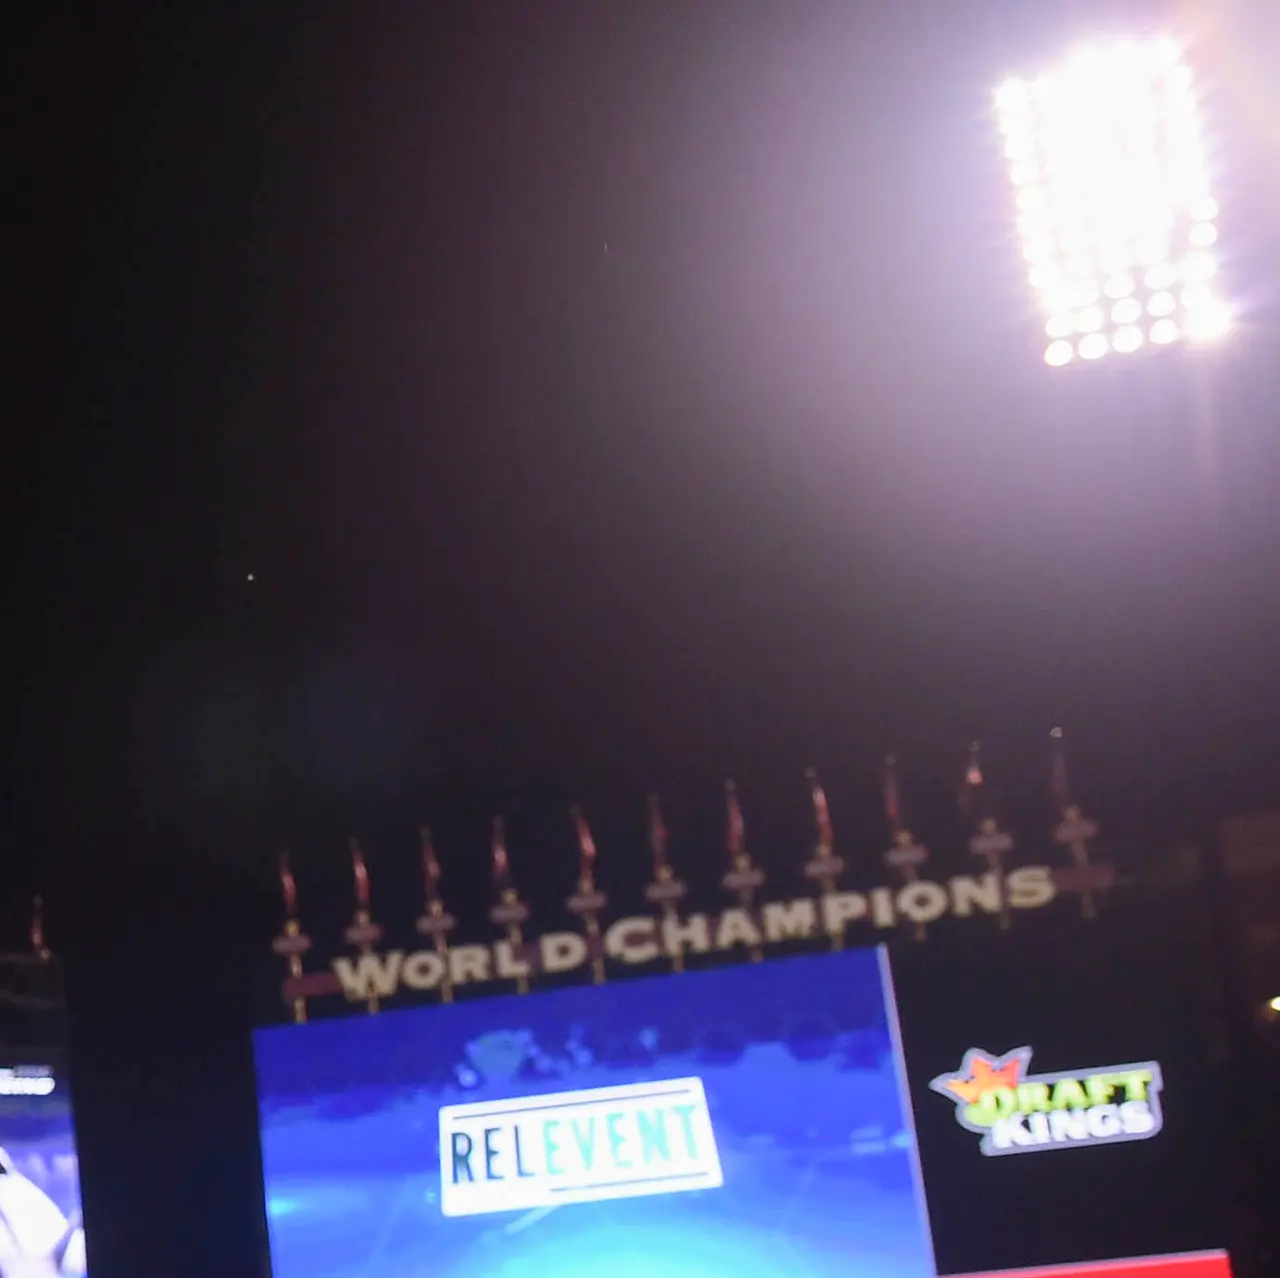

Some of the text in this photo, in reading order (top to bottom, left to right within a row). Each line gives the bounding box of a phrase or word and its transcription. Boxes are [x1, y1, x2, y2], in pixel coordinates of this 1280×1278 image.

[332, 866, 1057, 1001] WORLD CHAMPIONS
[964, 1070, 1152, 1127] DRAFT
[992, 1101, 1154, 1148] KINGS
[450, 1104, 696, 1185] RELEVENT
